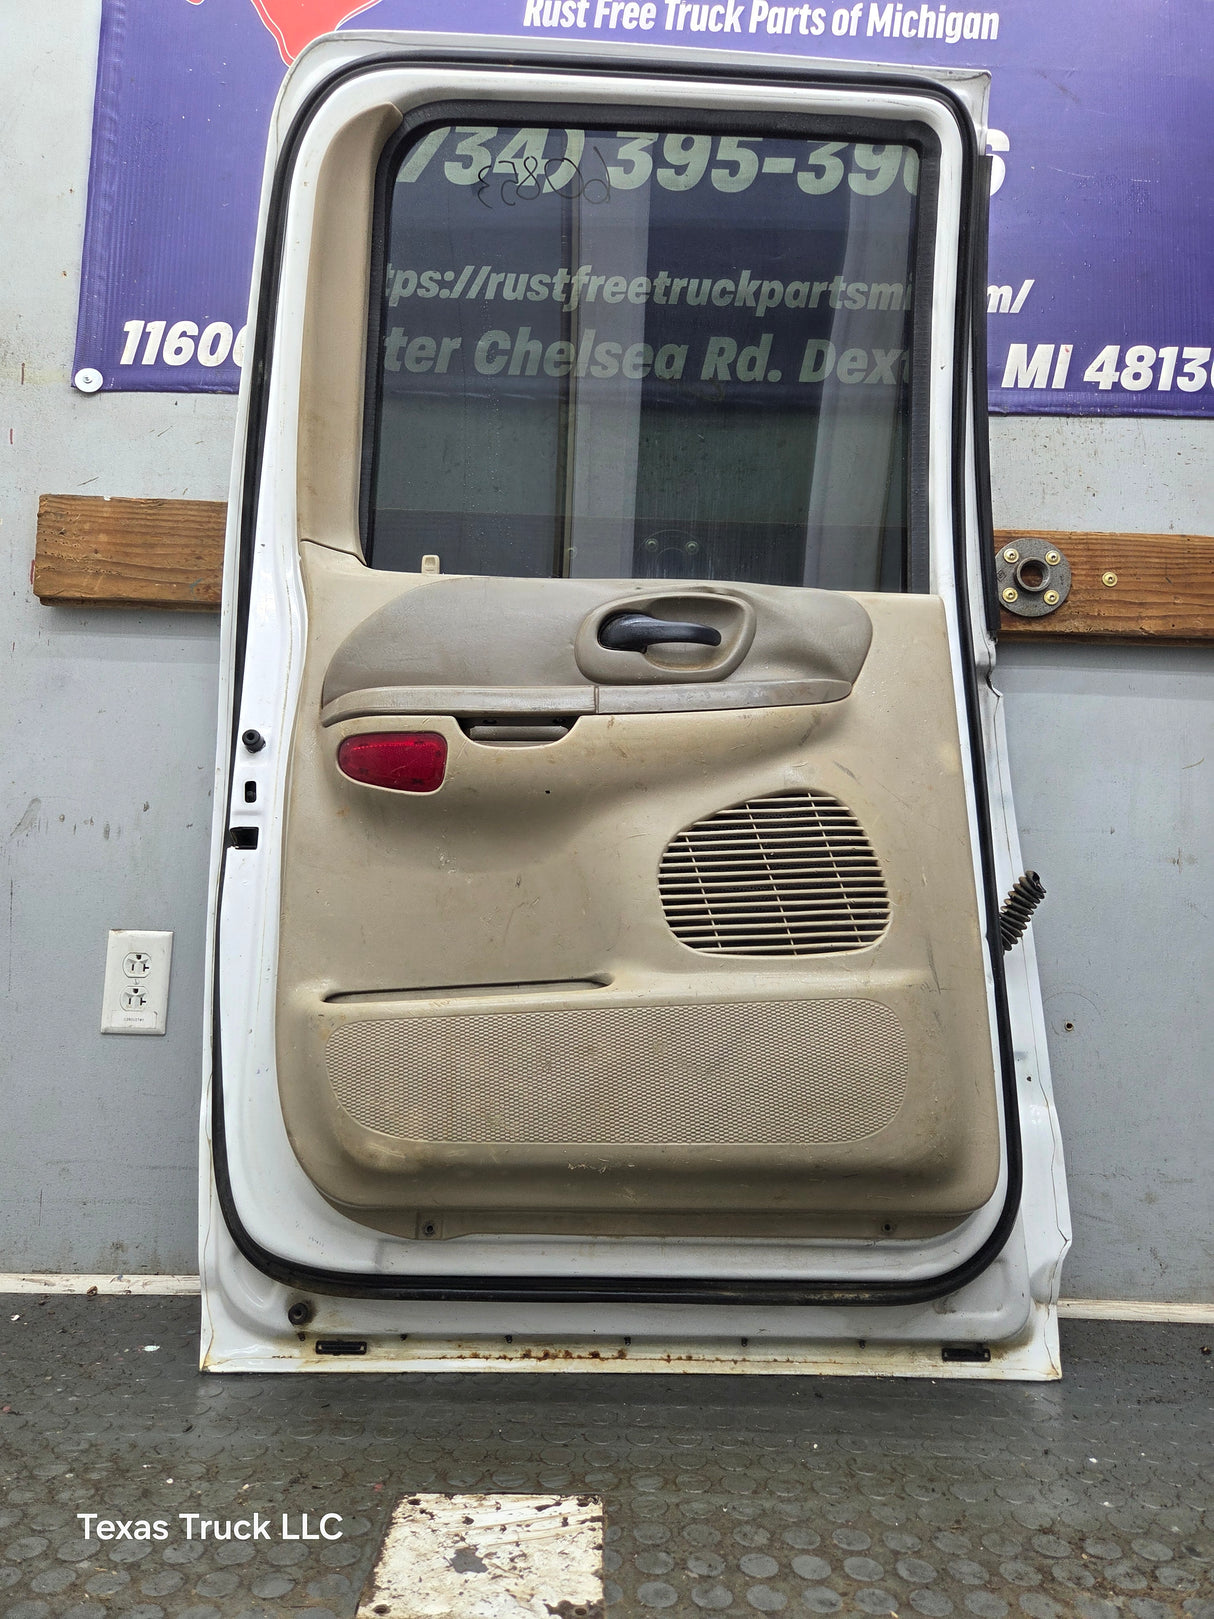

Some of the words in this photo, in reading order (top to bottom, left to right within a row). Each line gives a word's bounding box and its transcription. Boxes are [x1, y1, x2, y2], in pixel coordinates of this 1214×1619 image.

[523, 0, 590, 28] Rust
[594, 0, 657, 30] Free
[664, 0, 745, 33] Truck
[748, 0, 826, 36] Parts
[831, 3, 863, 36] of
[866, 3, 1000, 43] Michigan
[383, 326, 462, 374] ter
[474, 326, 688, 381] Chelsea
[700, 333, 783, 383] Rd.
[1001, 343, 1073, 389] MI
[1083, 345, 1214, 392] 4813
